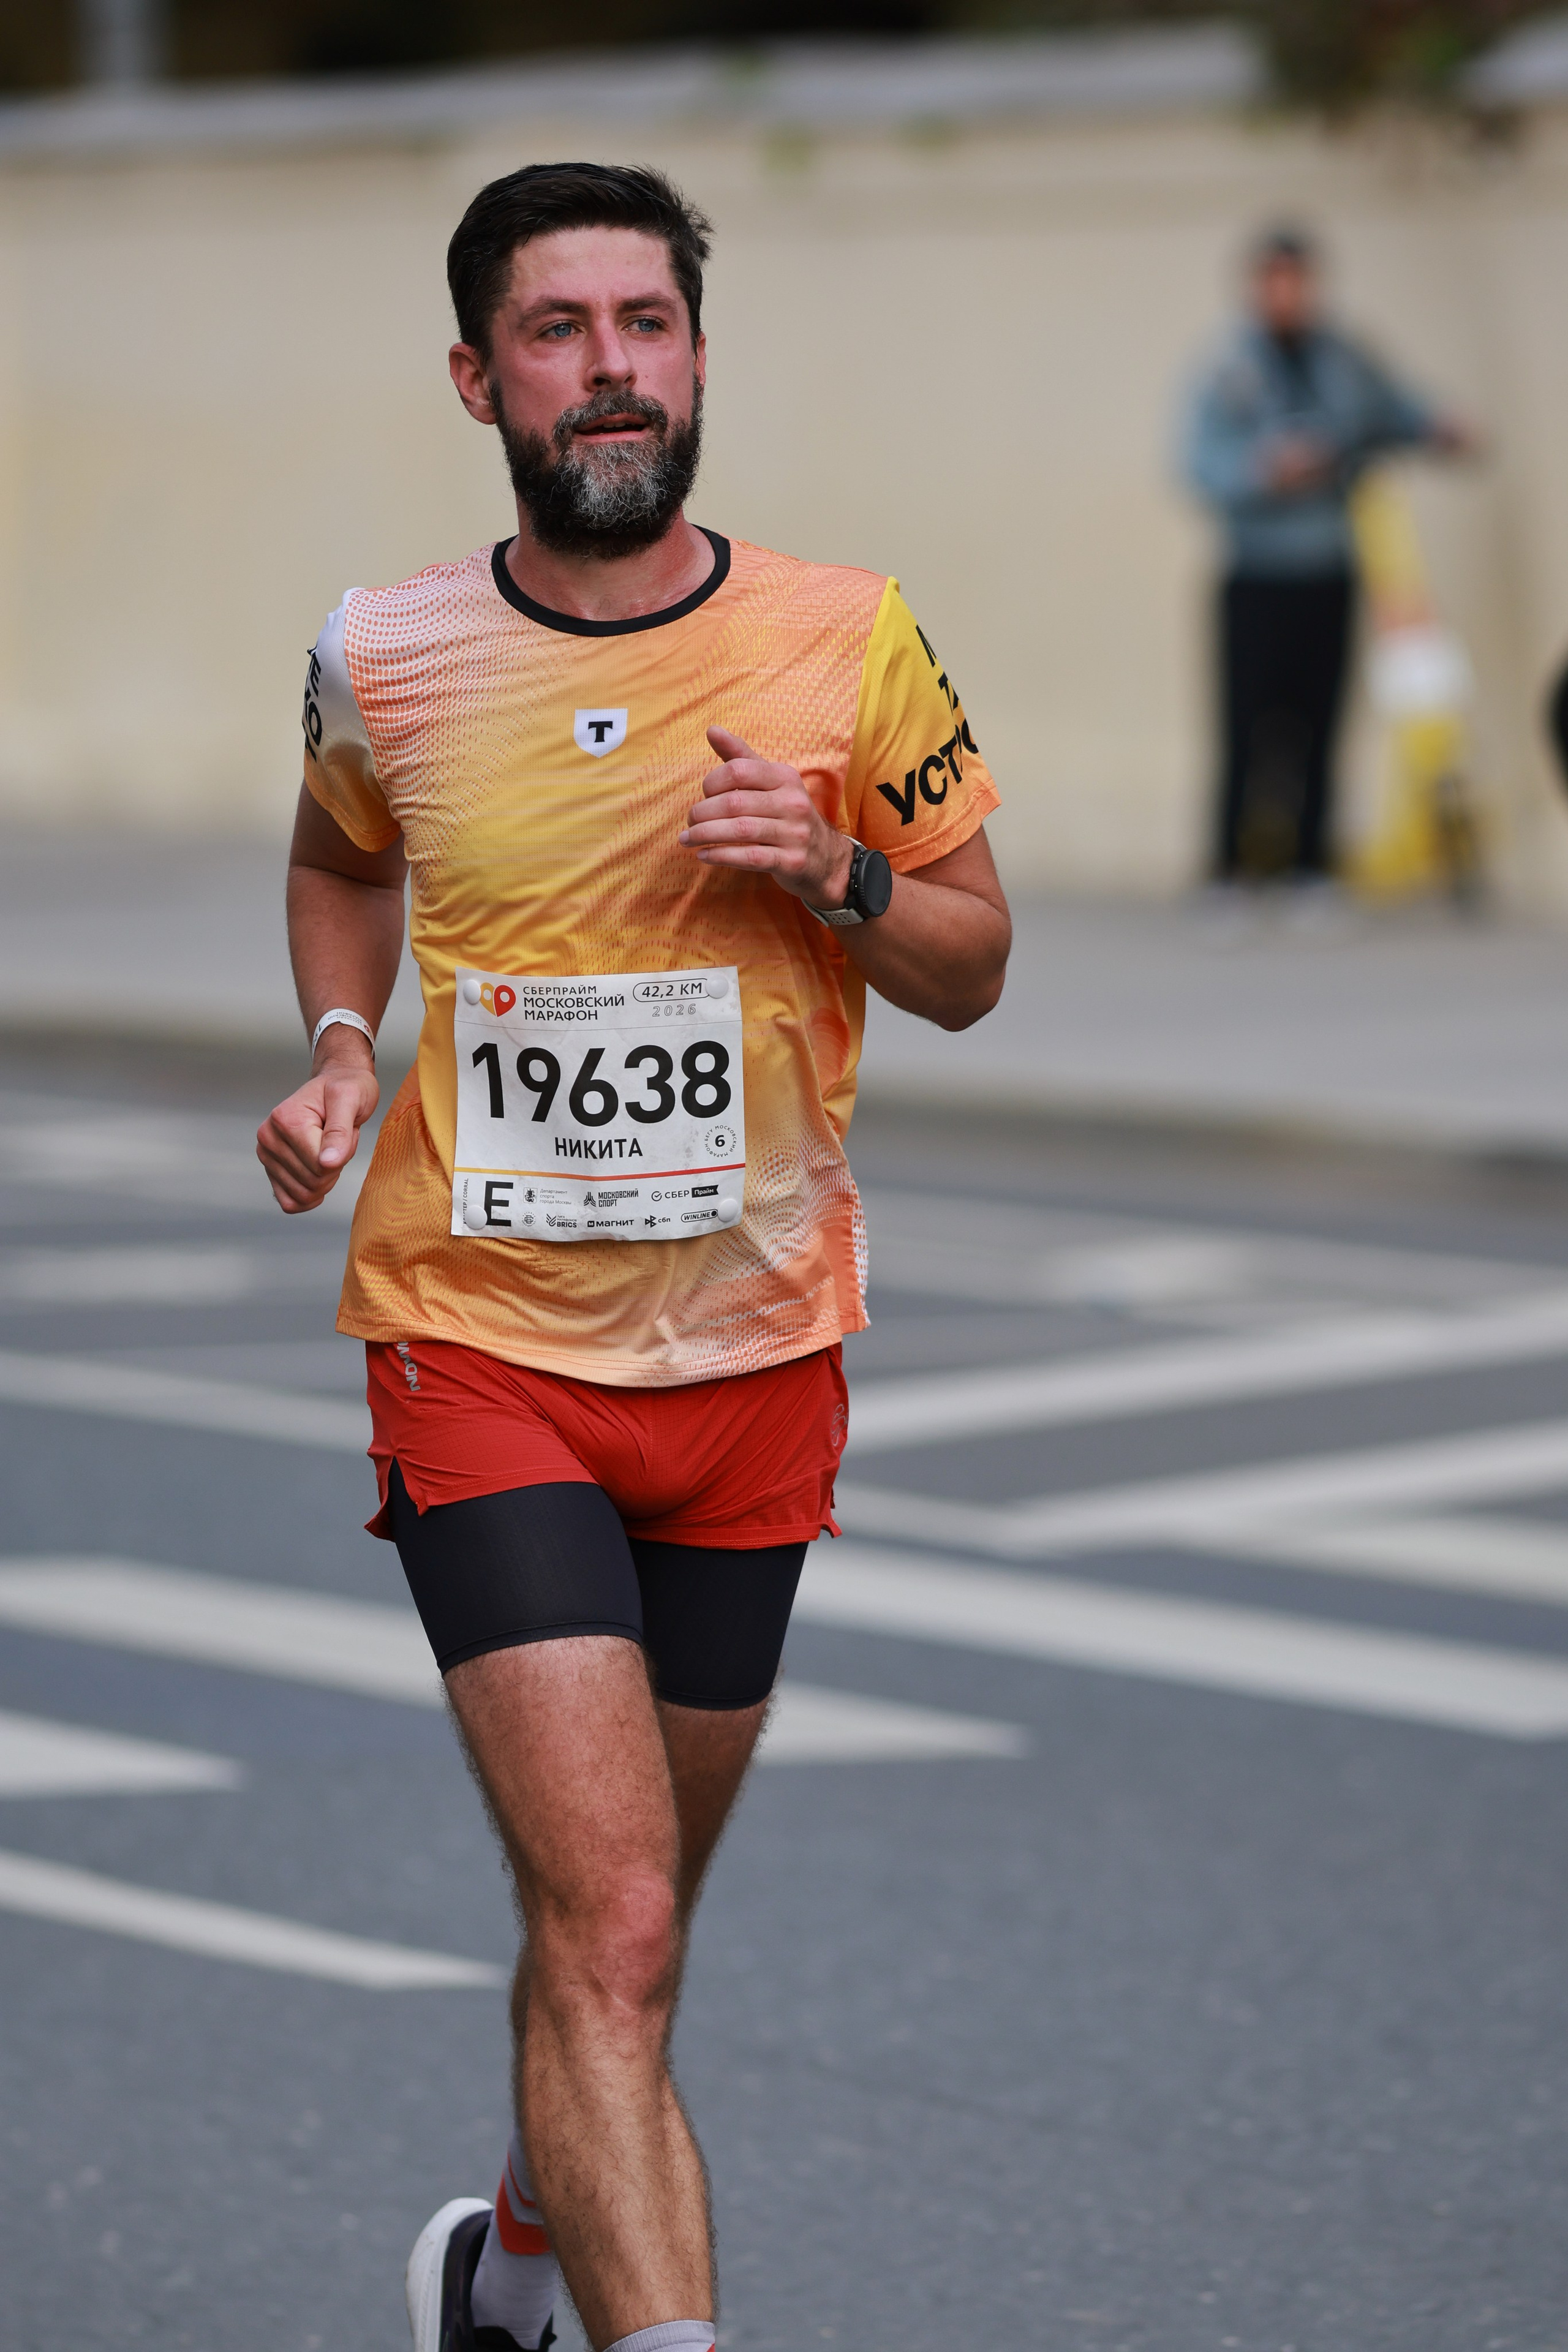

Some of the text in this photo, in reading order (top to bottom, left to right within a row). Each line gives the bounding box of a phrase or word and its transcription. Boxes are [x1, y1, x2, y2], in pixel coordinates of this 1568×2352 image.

[588, 721, 613, 743] Т
[522, 984, 597, 995] СБЕРПРАЙМ
[642, 982, 703, 998] 42,2 КМ
[524, 994, 625, 1008] МОСКОВСКИЙ
[524, 1010, 598, 1021] МАРАФОН
[652, 1004, 696, 1017] 2026
[472, 1040, 731, 1127] 19638
[715, 1125, 737, 1152] МОСКОВСКИЙ
[715, 1134, 725, 1147] 6
[554, 1137, 643, 1159] НИКИТА
[704, 1143, 728, 1158] МАРАФОН
[598, 1188, 639, 1199] МОСКОВСКИЙ
[665, 1190, 690, 1199] СБЕР
[684, 1212, 710, 1221] WINLINE
